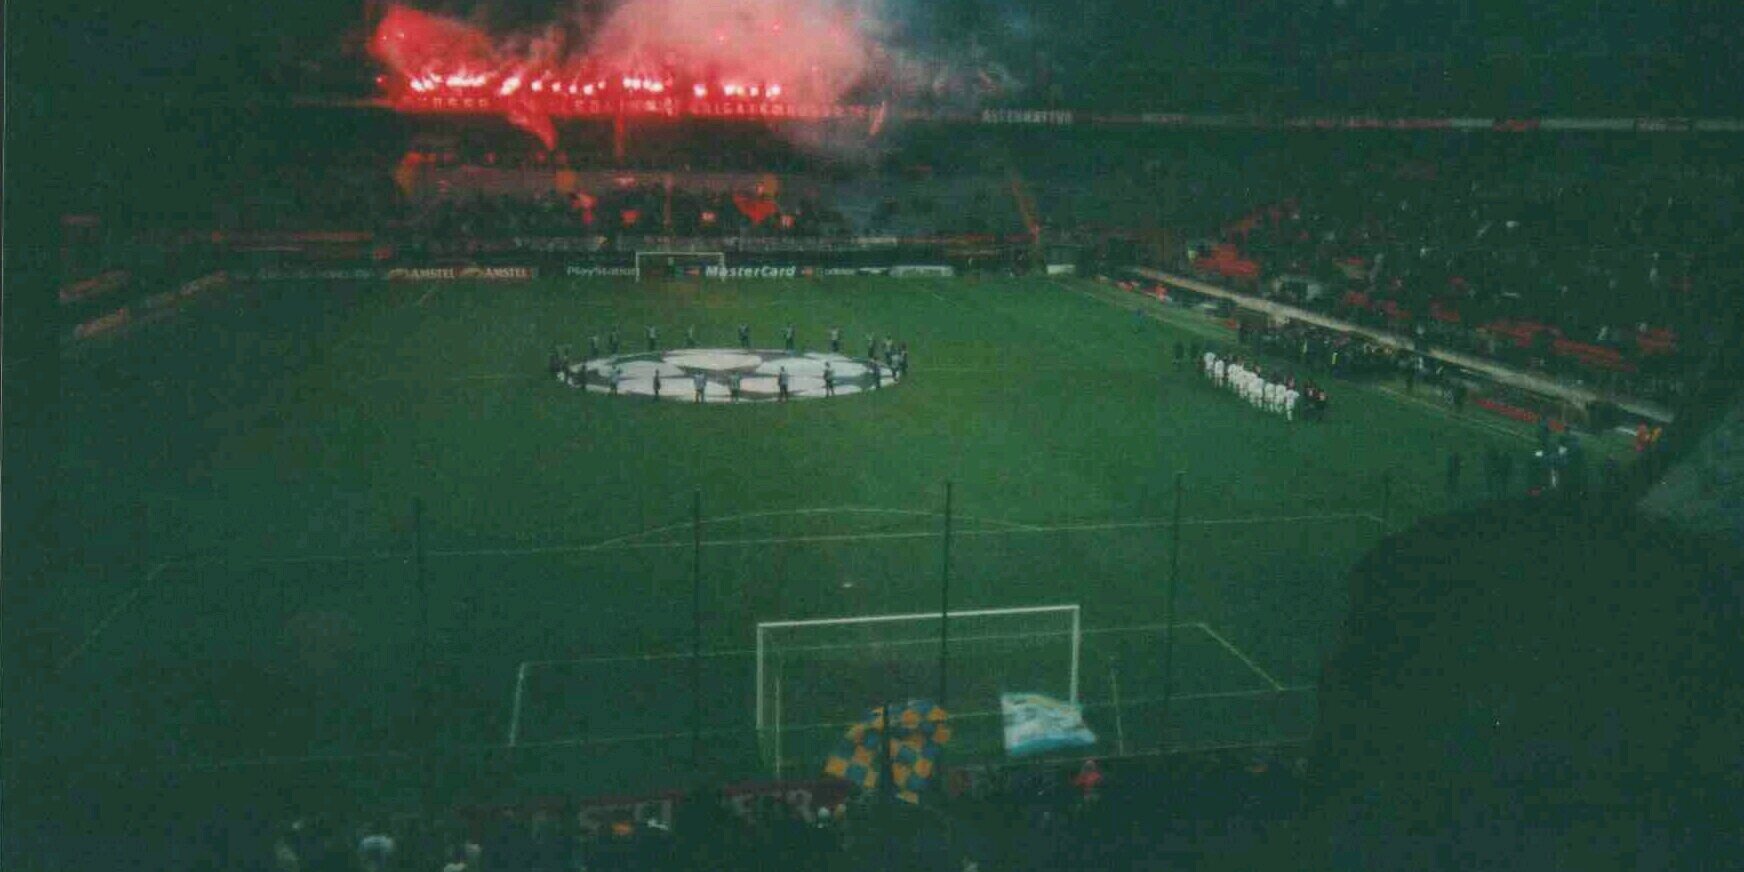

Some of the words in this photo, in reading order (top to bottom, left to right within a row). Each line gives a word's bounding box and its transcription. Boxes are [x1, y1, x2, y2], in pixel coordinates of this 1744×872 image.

[409, 267, 455, 279] AMSTEL
[485, 267, 526, 279] AMSTEL
[704, 265, 797, 278] MasterCard
